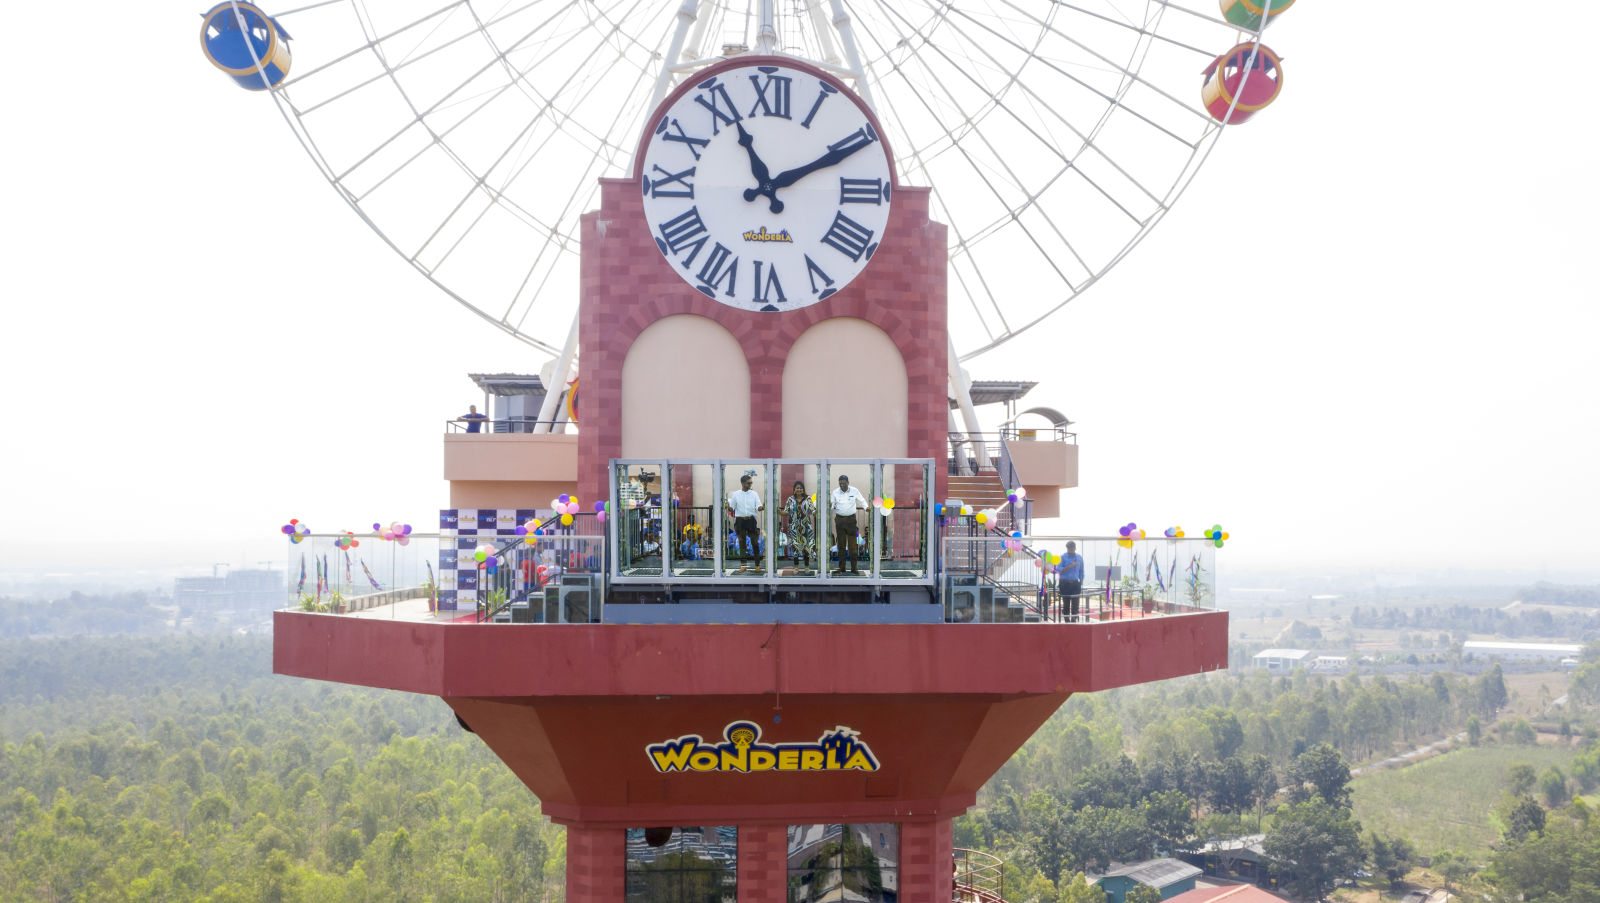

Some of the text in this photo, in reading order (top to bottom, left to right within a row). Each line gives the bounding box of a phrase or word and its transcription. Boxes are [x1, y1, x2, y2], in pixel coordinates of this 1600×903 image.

[694, 83, 744, 136] XI
[748, 75, 793, 121] XII
[800, 90, 829, 129] I
[662, 118, 711, 161] X
[826, 127, 874, 154] I
[651, 163, 697, 199] IX
[839, 176, 883, 206] III
[658, 205, 711, 270] VIII
[743, 228, 793, 243] WONDERLA
[819, 210, 875, 263] IIII
[696, 241, 739, 297] VII
[752, 259, 788, 303] VI
[803, 252, 835, 294] V
[652, 740, 874, 772] WONDERLA
